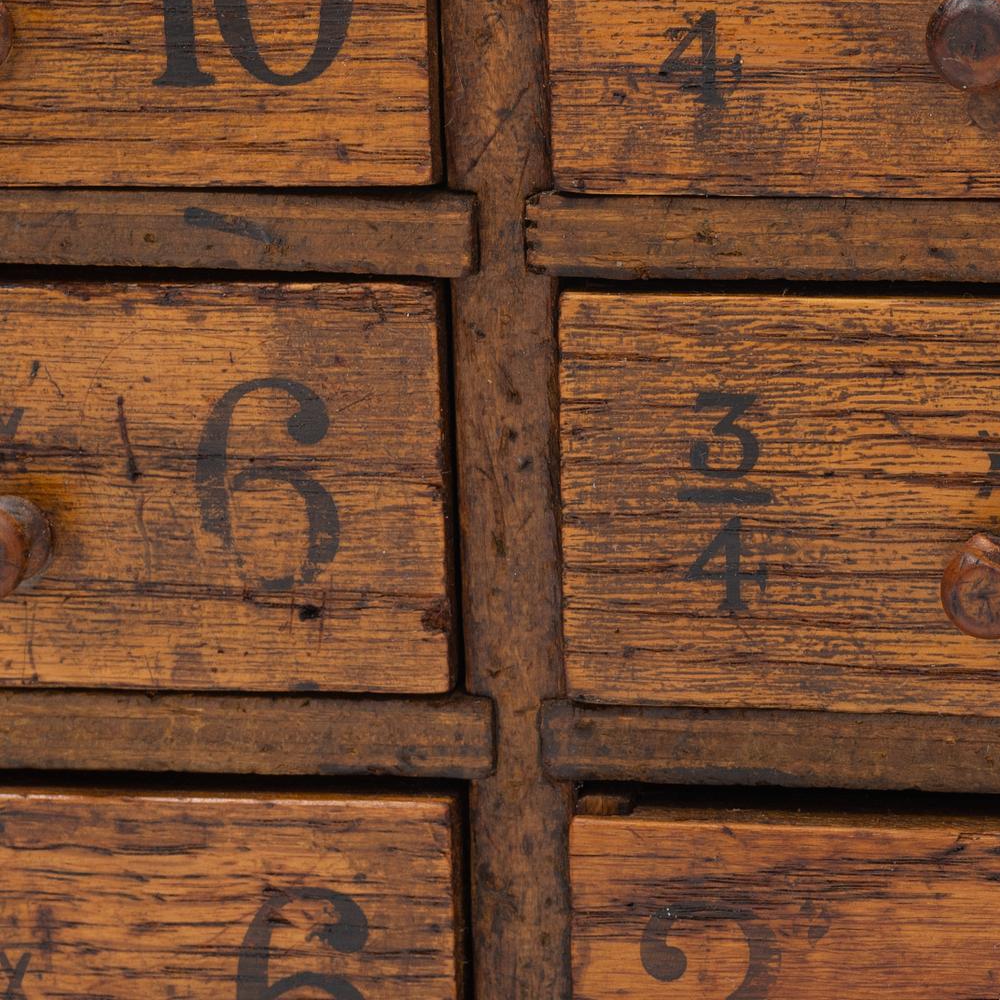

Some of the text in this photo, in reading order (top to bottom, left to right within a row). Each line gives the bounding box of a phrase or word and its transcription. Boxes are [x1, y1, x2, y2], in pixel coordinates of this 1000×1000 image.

[657, 8, 744, 108] 4
[196, 377, 341, 590] 6
[690, 391, 762, 479] 3
[681, 514, 770, 612] 4
